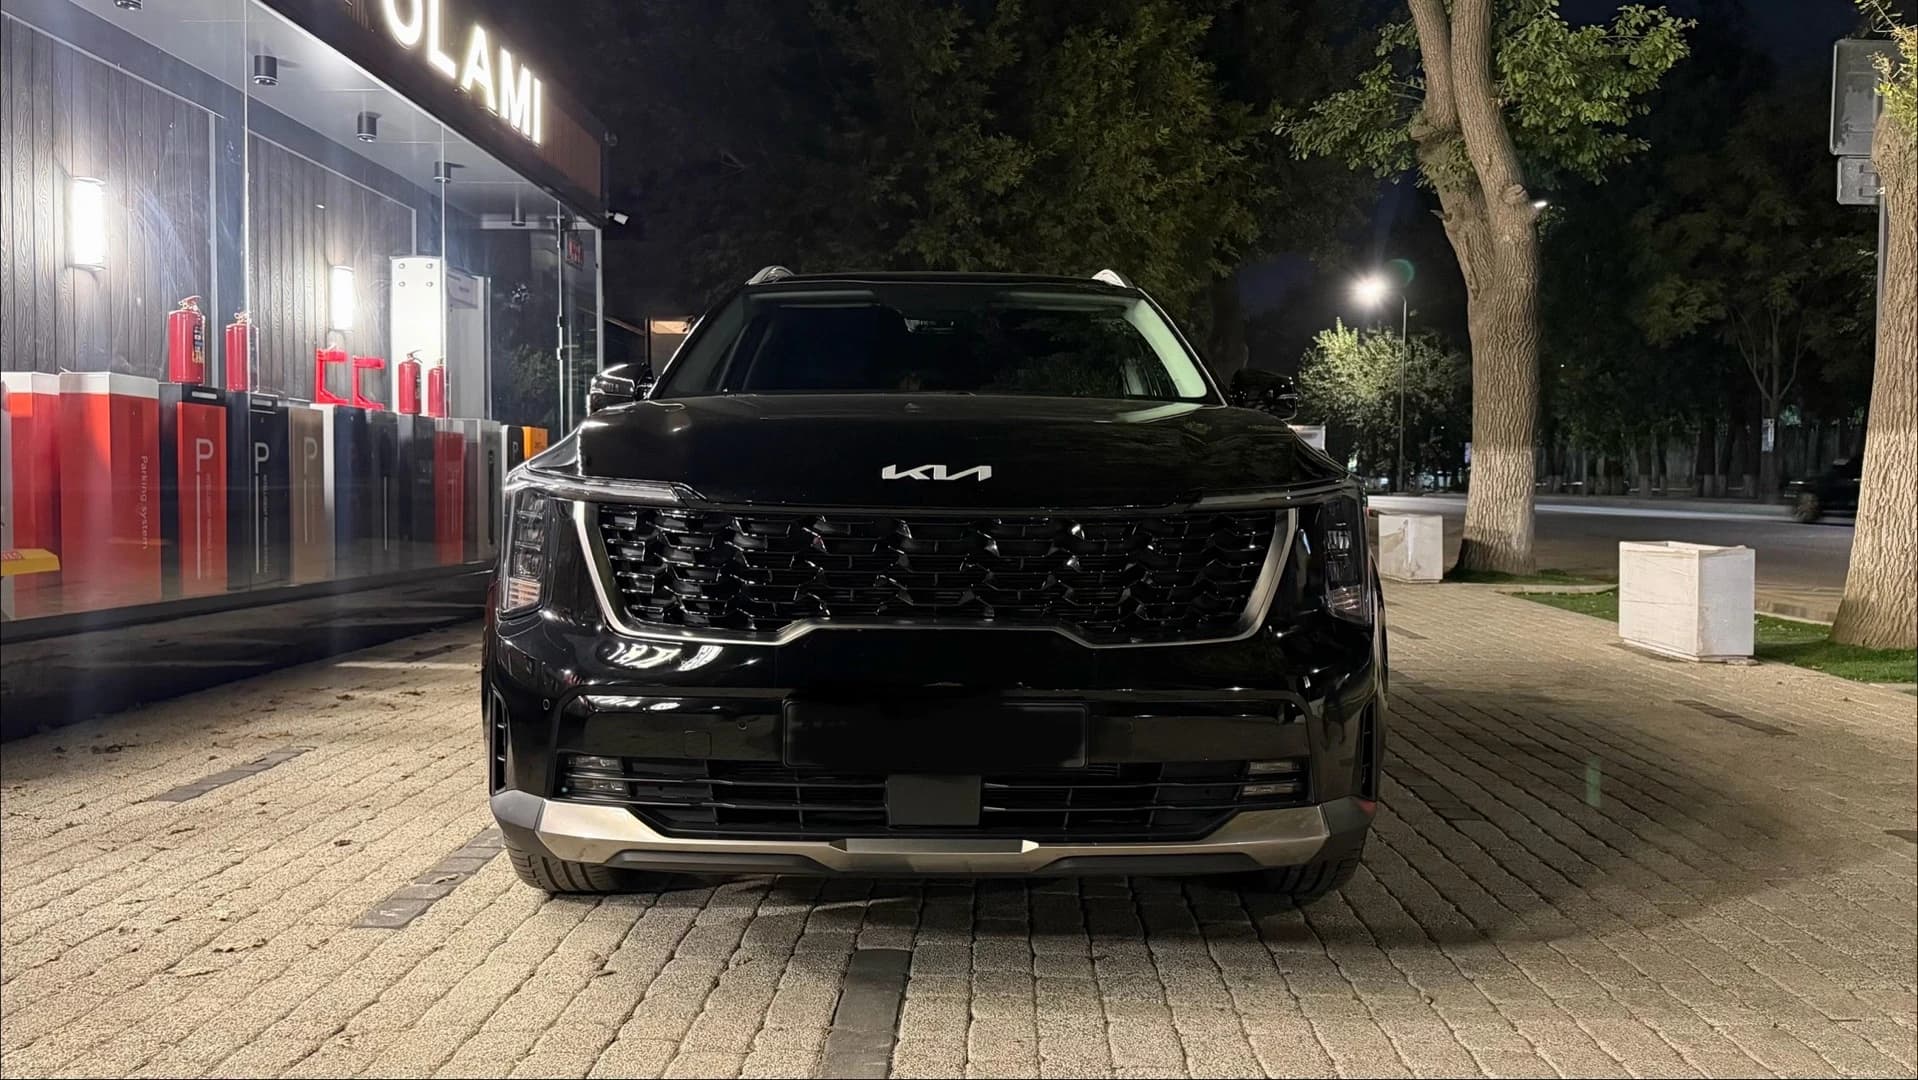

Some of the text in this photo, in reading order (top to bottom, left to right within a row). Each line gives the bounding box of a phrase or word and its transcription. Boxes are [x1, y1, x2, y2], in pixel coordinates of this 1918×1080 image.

[195, 438, 214, 472] P
[254, 442, 270, 473] P
[882, 464, 992, 481] KIA
[138, 455, 149, 549] Parking system
